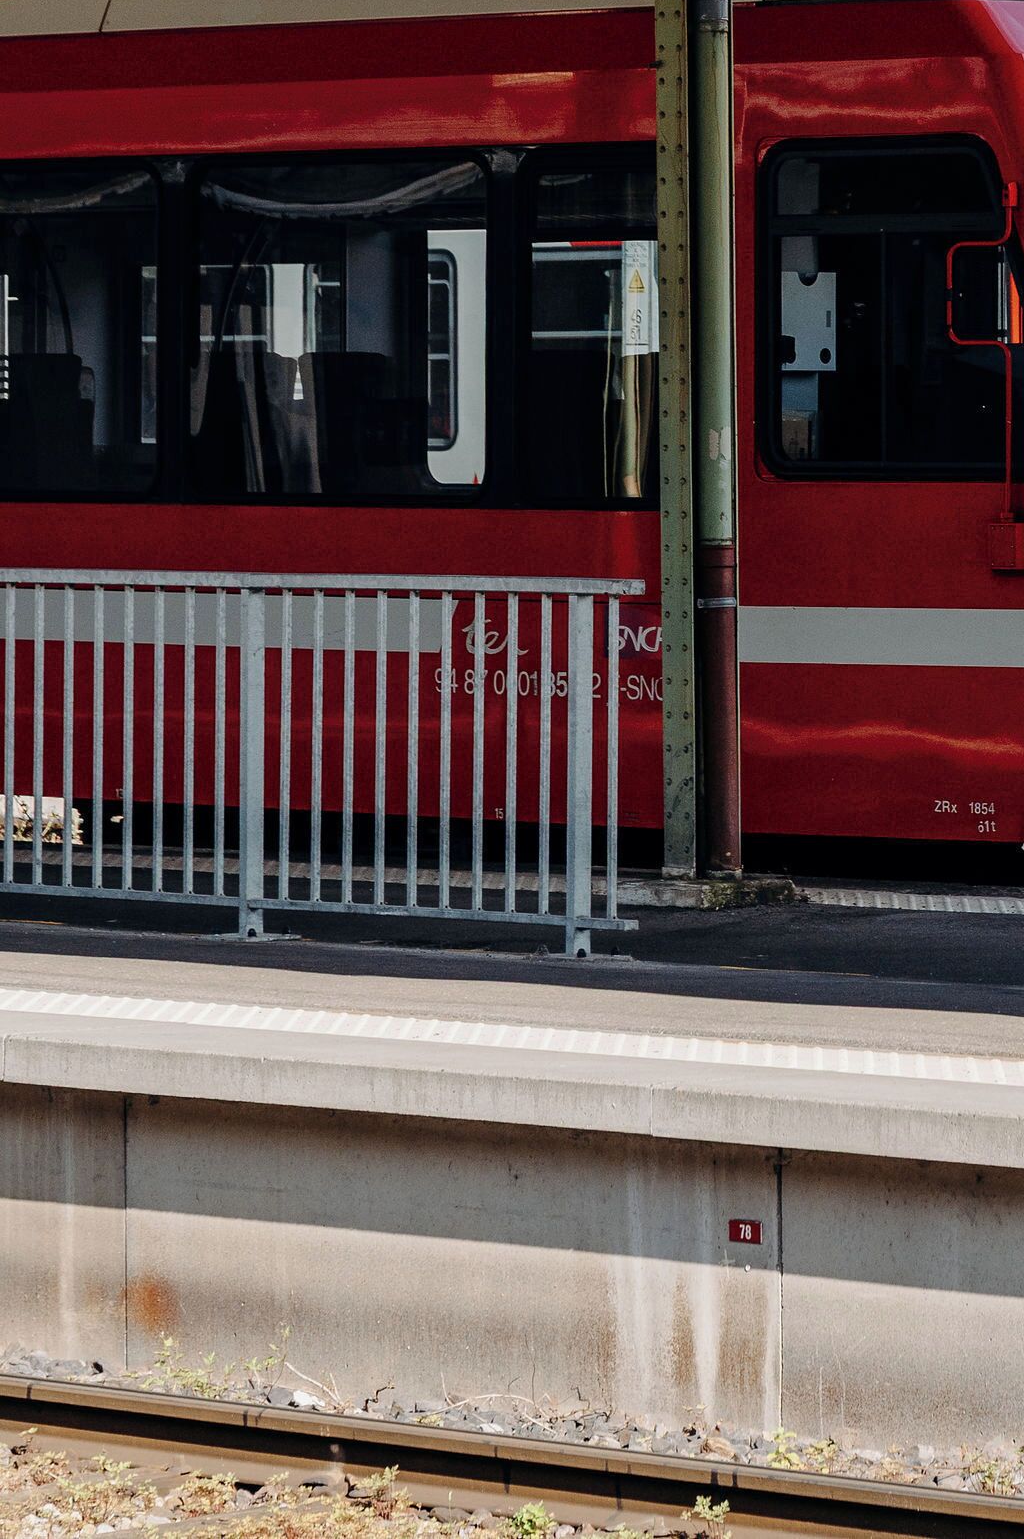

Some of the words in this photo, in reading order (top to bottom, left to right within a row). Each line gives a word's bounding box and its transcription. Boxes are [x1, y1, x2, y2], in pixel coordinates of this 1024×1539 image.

[464, 668, 489, 695] 8
[934, 800, 958, 814] ZRx
[968, 801, 996, 815] 1854
[739, 1224, 752, 1240] 78
